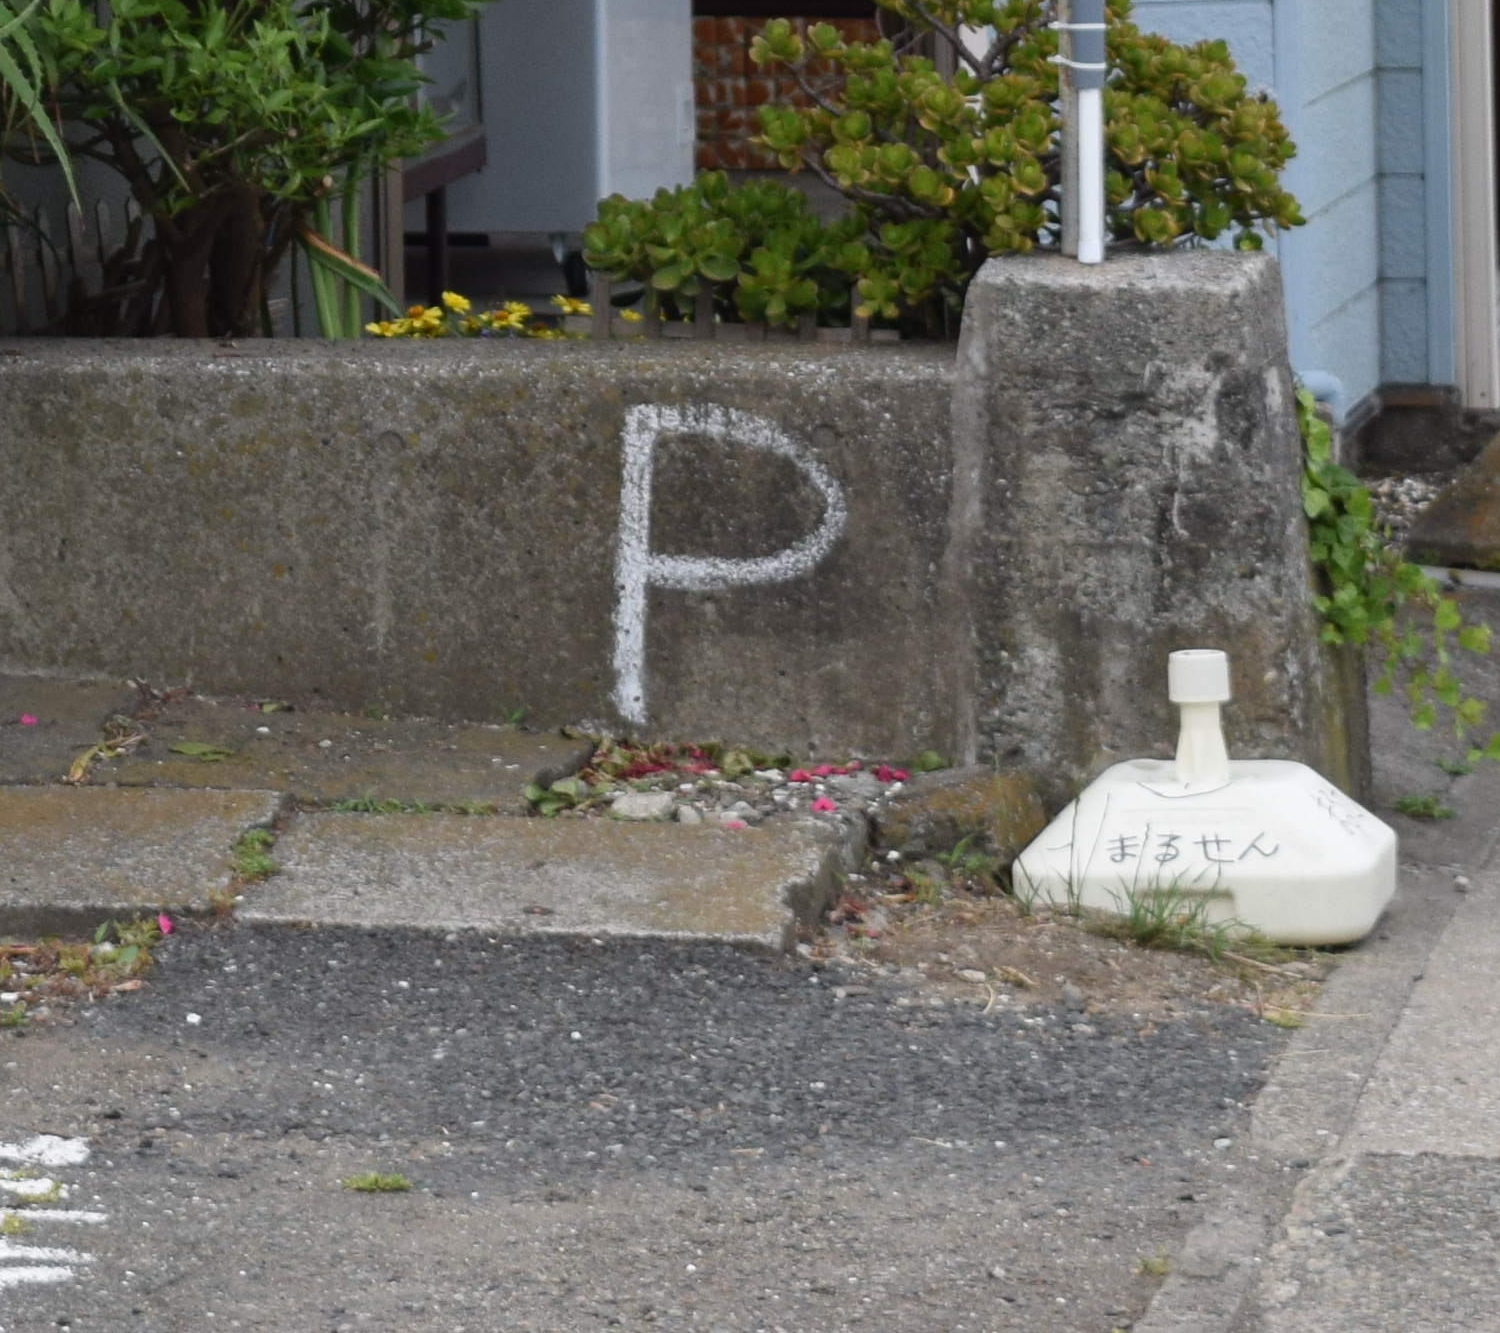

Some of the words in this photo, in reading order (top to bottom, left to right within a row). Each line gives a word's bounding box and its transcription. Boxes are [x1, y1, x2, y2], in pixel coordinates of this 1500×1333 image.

[611, 401, 849, 729] P
[1105, 831, 1280, 865] まるせん
